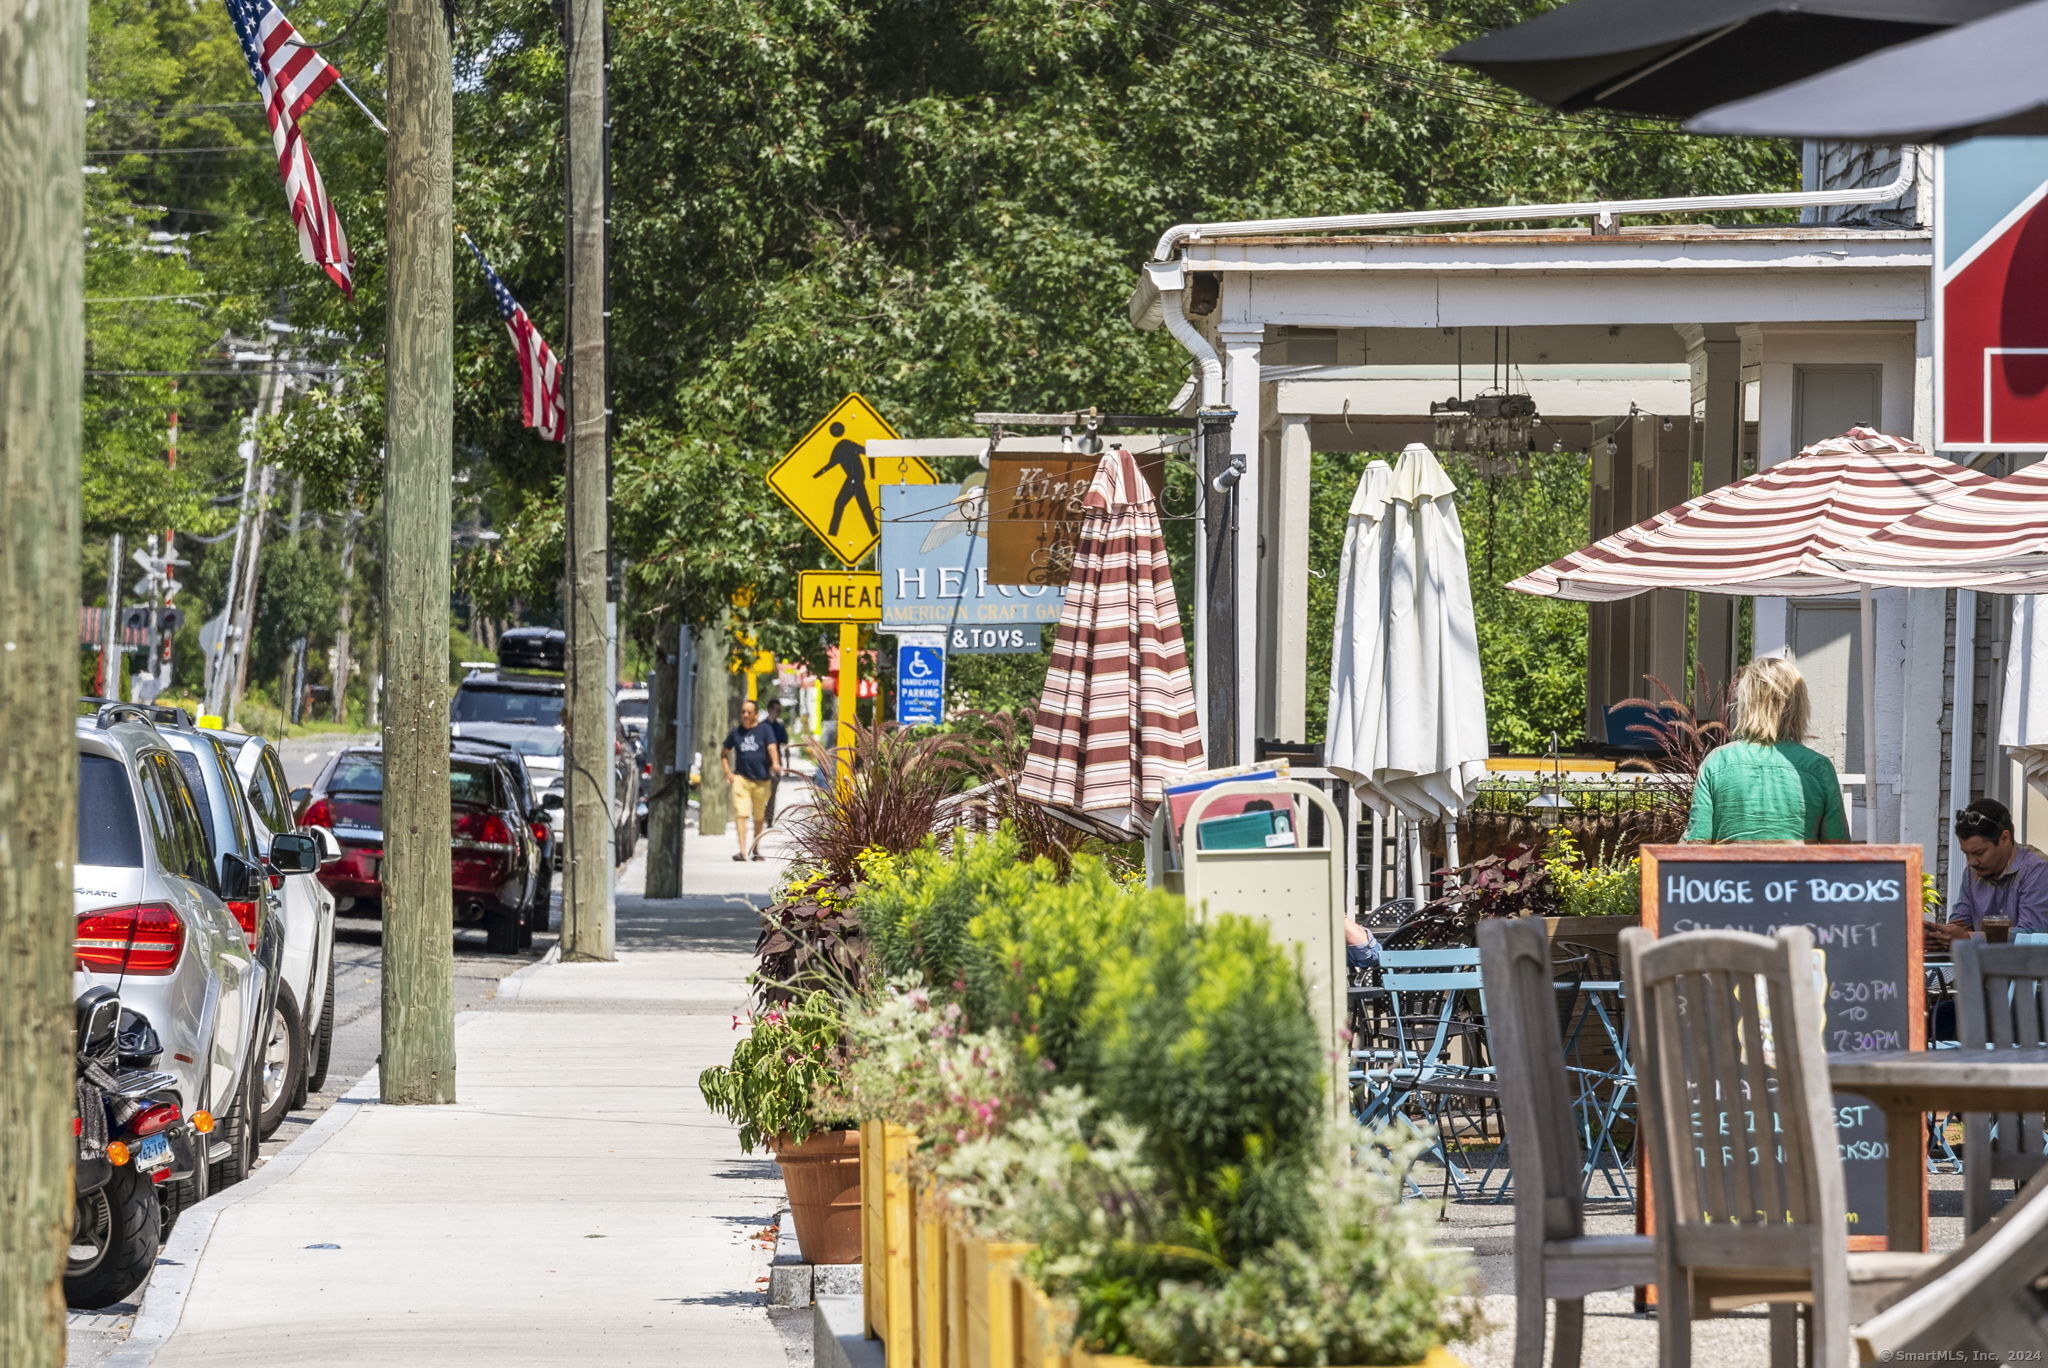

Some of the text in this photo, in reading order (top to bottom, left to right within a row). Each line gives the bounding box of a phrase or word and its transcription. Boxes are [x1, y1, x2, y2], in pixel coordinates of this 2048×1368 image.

[884, 604, 969, 622] AMERICAN
[976, 603, 1031, 621] CRAFT
[901, 687, 940, 699] PARKING
[1667, 875, 1900, 904] HOUSE OF BOOKS
[1870, 980, 1898, 1001] PM
[1838, 1006, 1868, 1021] TO
